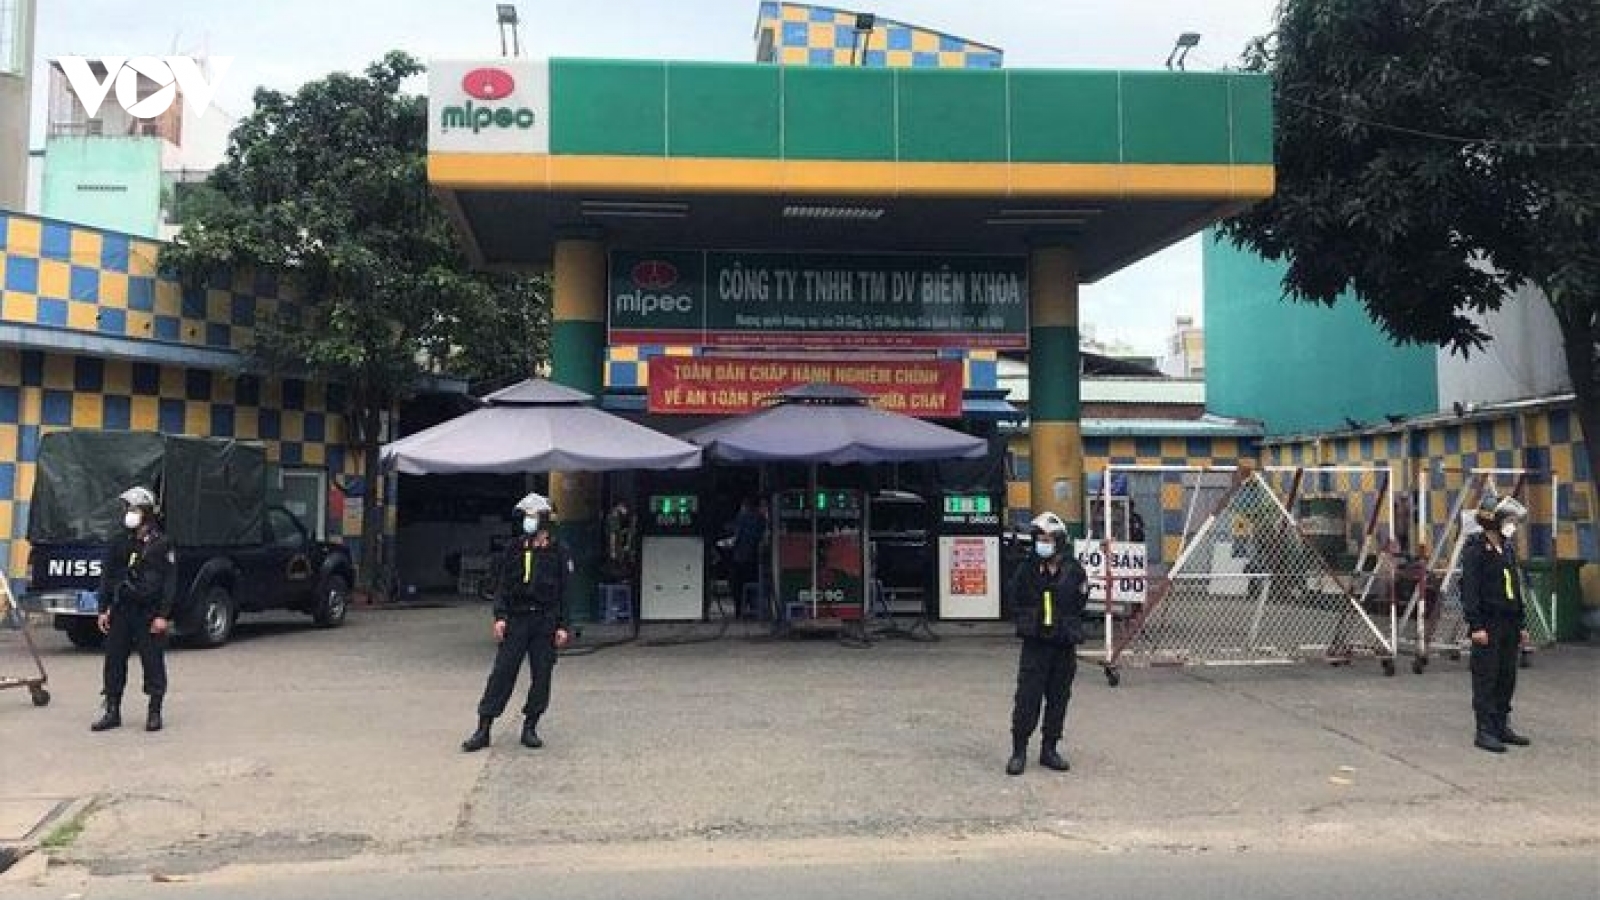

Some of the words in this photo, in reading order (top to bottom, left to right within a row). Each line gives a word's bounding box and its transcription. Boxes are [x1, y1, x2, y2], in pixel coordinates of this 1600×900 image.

[441, 99, 535, 134] mipec
[719, 262, 769, 301] CÔNG
[774, 270, 798, 302] TY
[804, 270, 853, 302] TNHH
[857, 271, 886, 303] TM
[892, 271, 915, 303] DV
[922, 264, 965, 304] BIÊN
[970, 272, 1020, 304] KHOA
[615, 289, 694, 316] mipec
[48, 559, 102, 577] NISS
